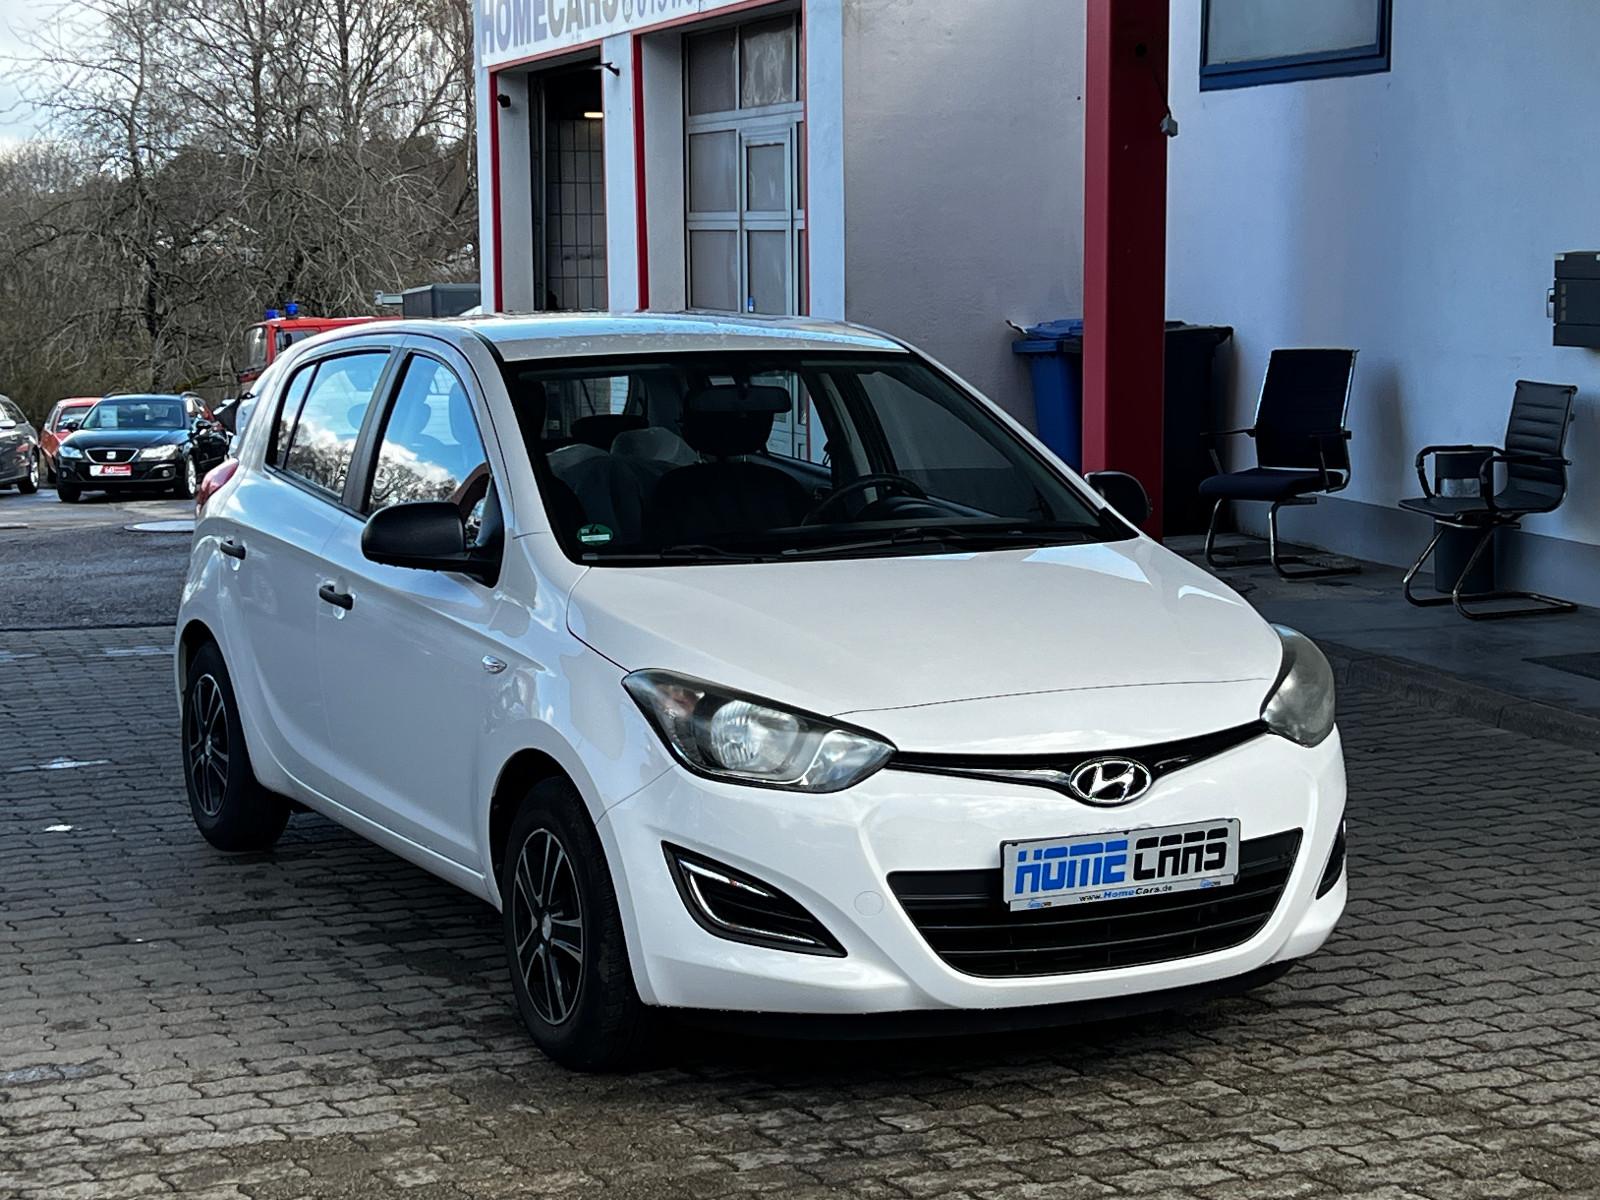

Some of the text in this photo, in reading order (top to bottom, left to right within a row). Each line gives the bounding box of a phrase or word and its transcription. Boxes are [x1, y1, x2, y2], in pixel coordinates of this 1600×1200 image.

[1015, 827, 1229, 894] HOME CARS
[1079, 884, 1173, 902] www.HomeCars.de
